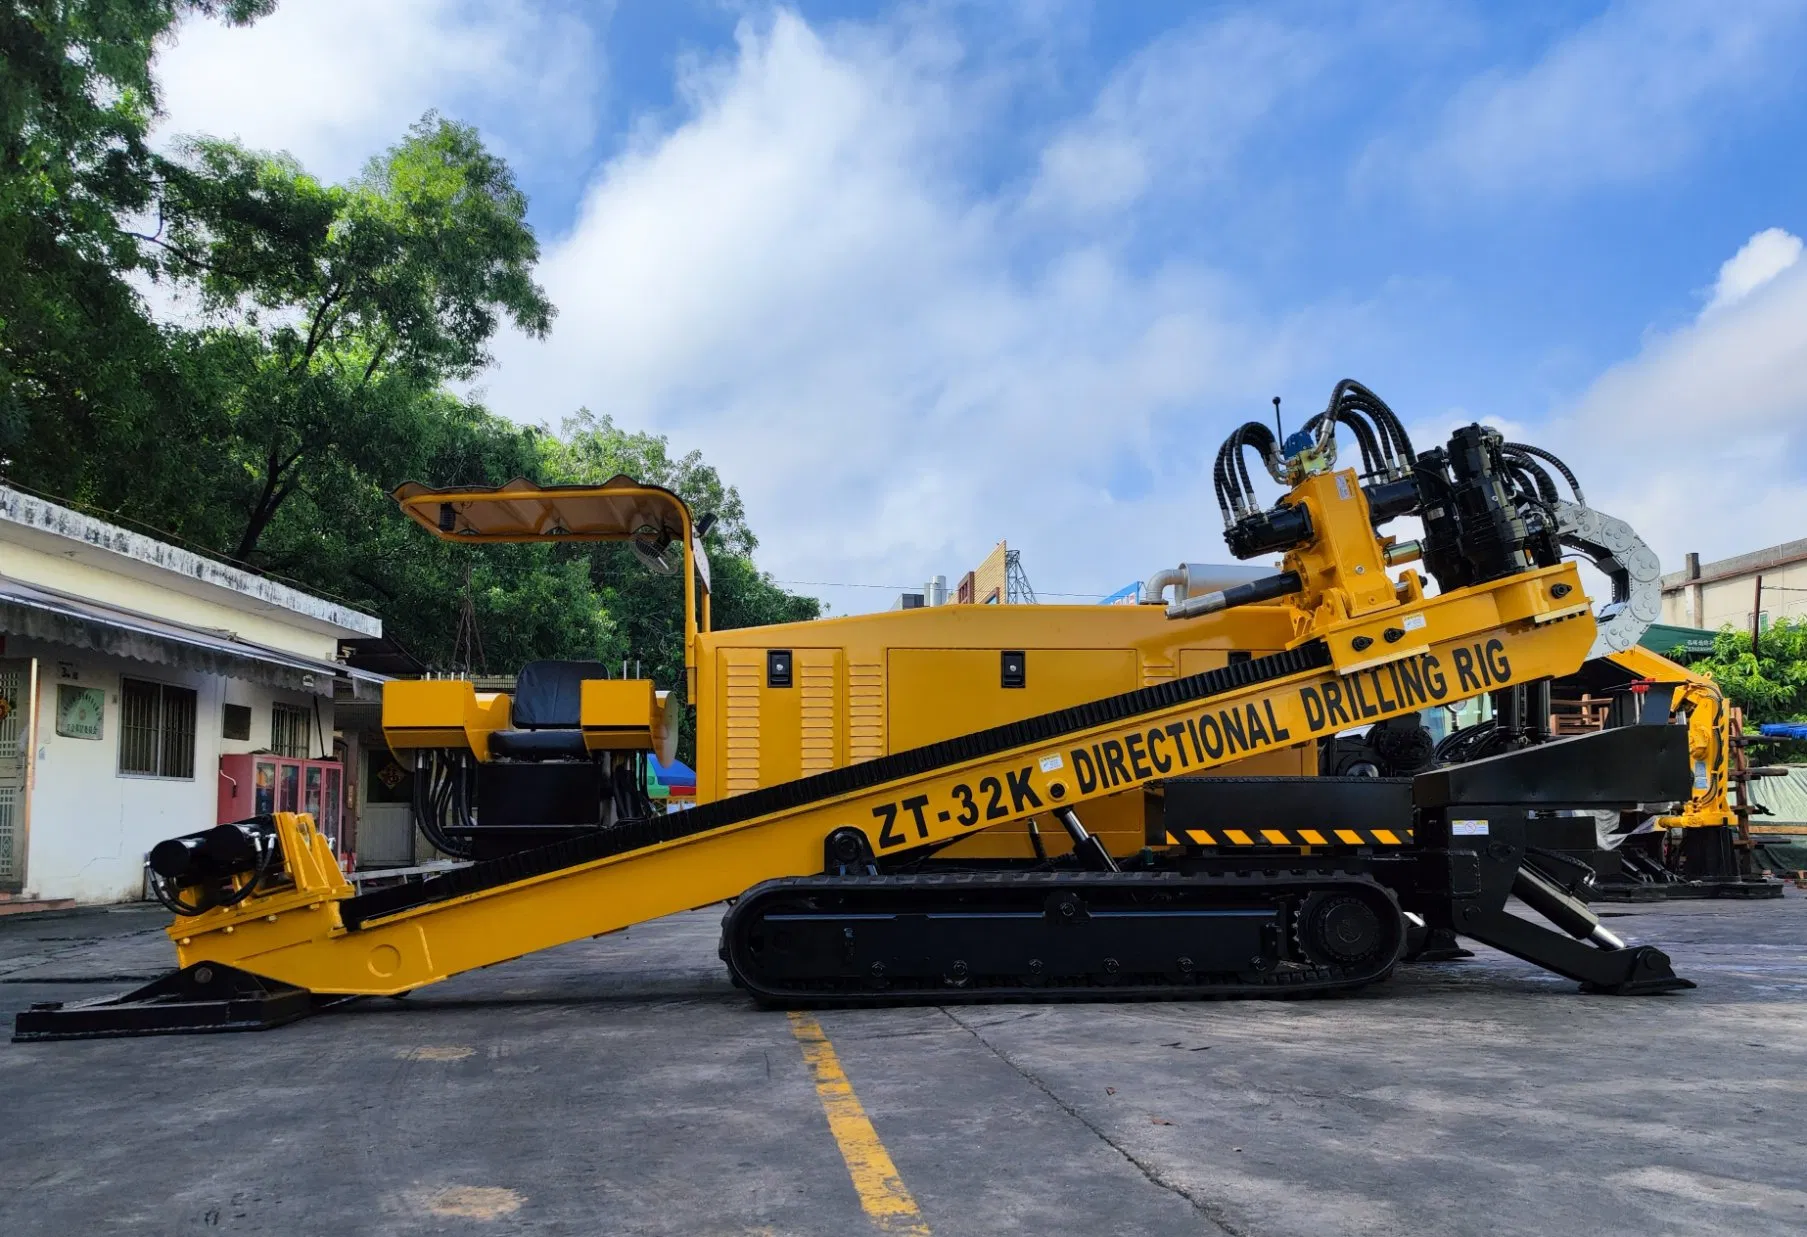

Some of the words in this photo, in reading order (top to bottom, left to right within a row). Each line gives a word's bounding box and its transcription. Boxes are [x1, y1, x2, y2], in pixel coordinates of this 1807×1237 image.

[873, 767, 1043, 849] ZT-32K
[1071, 699, 1291, 795] DIRECTIONAL
[1300, 654, 1448, 732] DRILLING
[1452, 639, 1511, 692] RIG
